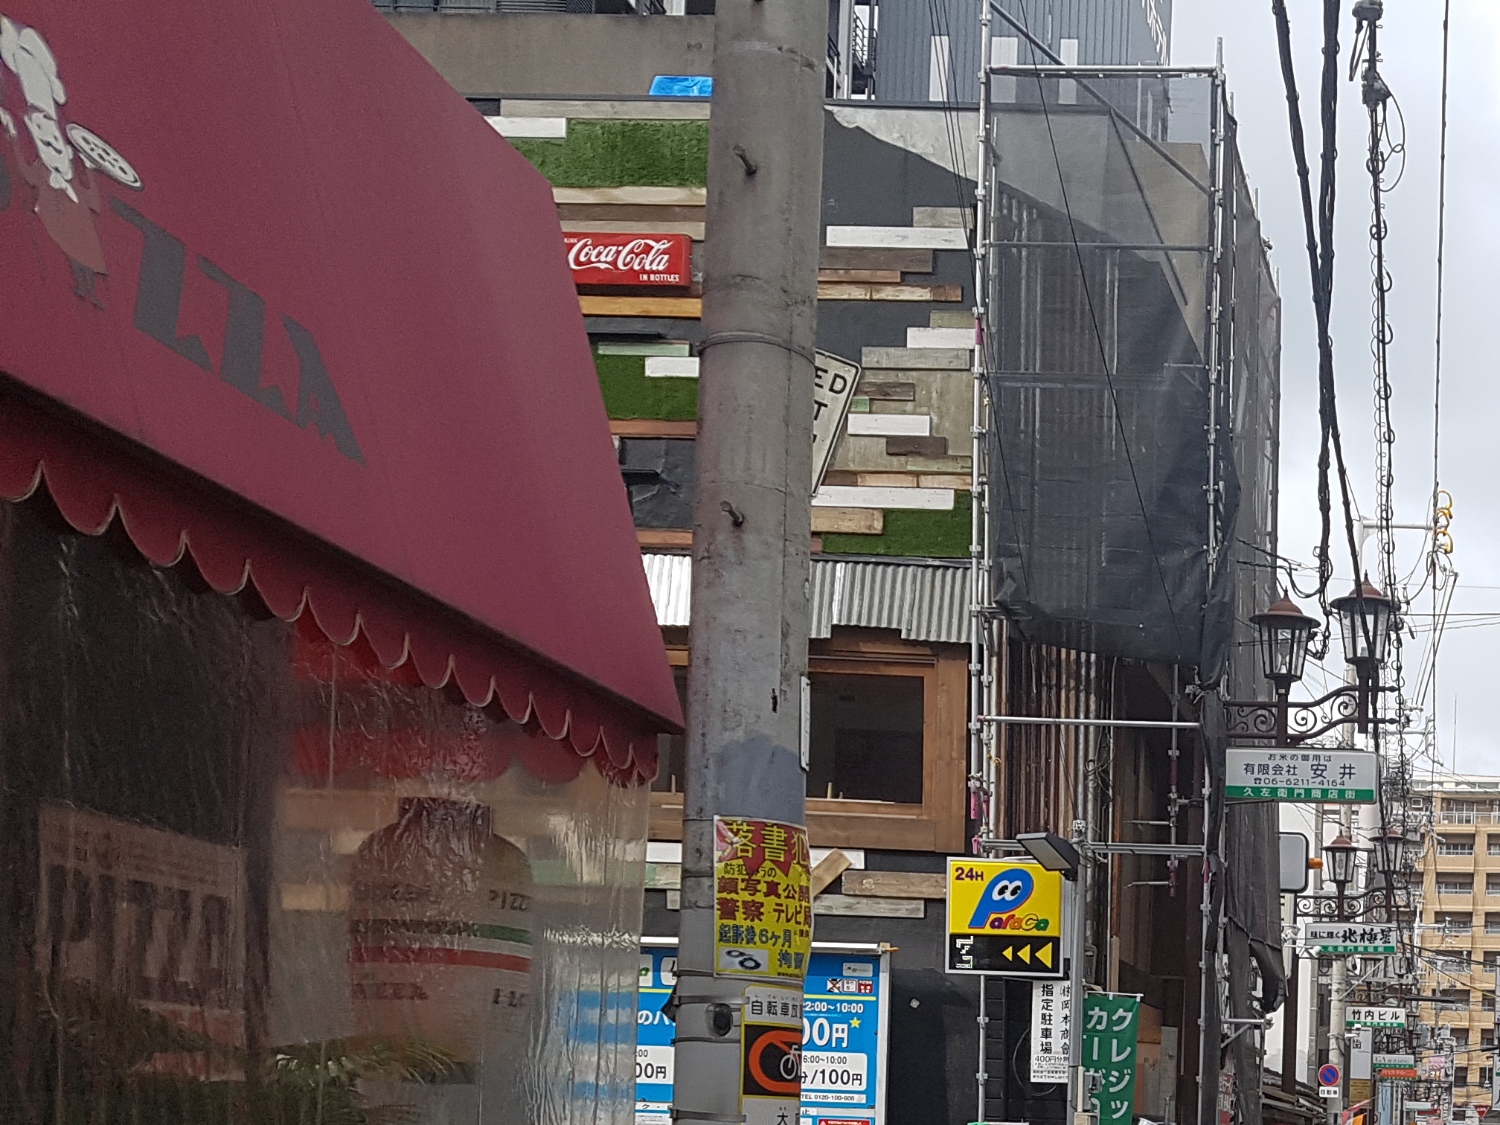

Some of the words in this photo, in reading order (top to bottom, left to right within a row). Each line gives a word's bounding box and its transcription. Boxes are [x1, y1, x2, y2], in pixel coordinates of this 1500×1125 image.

[568, 238, 675, 270] Coca-Cola
[650, 274, 679, 282] BOTTLES
[1267, 753, 1332, 763] お米の御用は
[1243, 763, 1299, 777] 有限会社
[1243, 787, 1356, 799] 久左衛門商店街
[954, 866, 985, 882] 24H
[1040, 984, 1054, 1055] 指定駐車場
[1352, 1009, 1400, 1021] 竹内ビル
